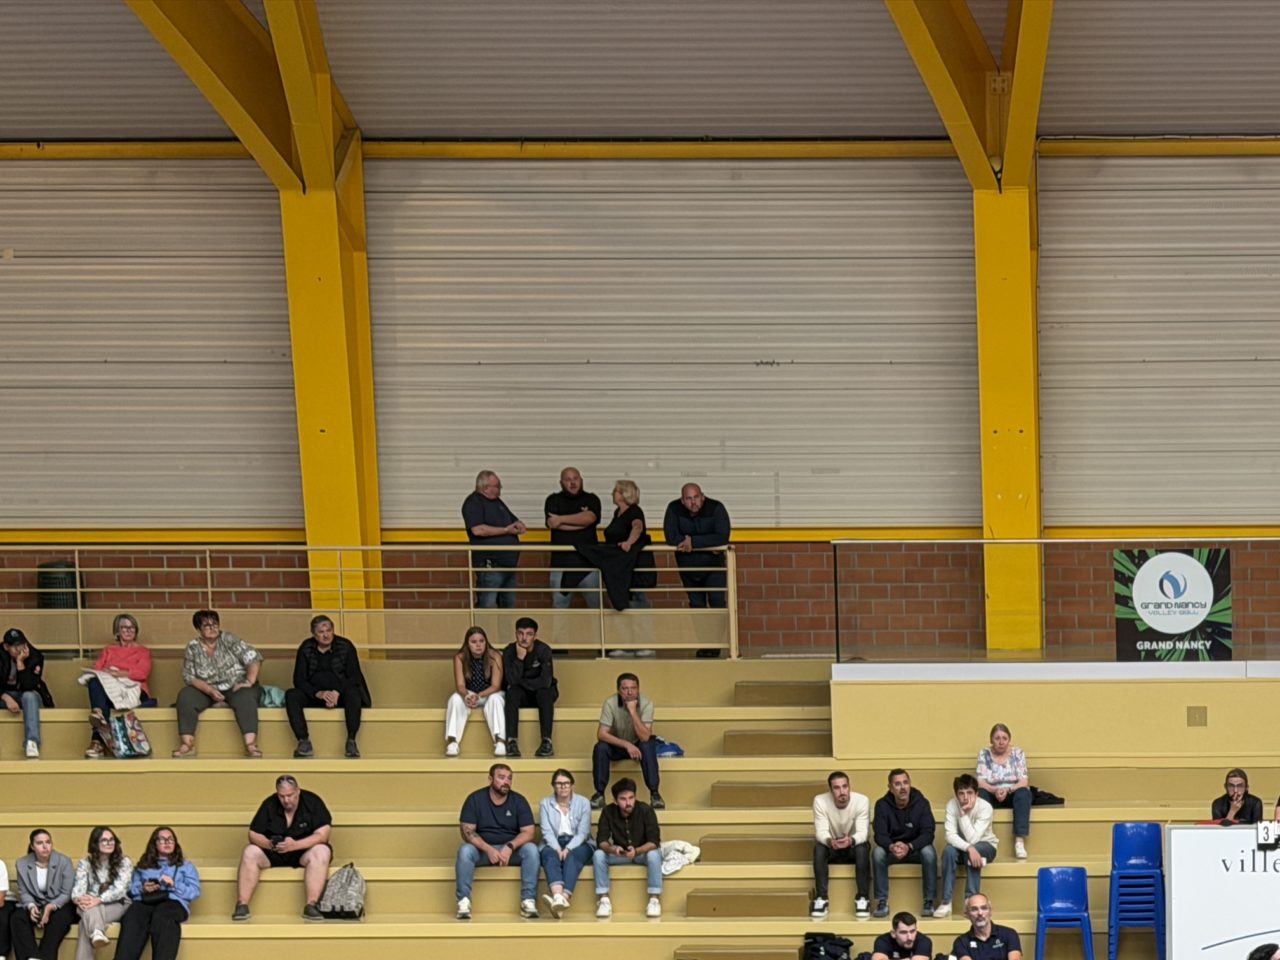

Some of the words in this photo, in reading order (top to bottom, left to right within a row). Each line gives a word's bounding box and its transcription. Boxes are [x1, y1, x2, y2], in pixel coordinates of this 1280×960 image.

[1136, 640, 1174, 650] GRAND
[1175, 640, 1213, 650] NANCY
[1262, 825, 1270, 842] 3
